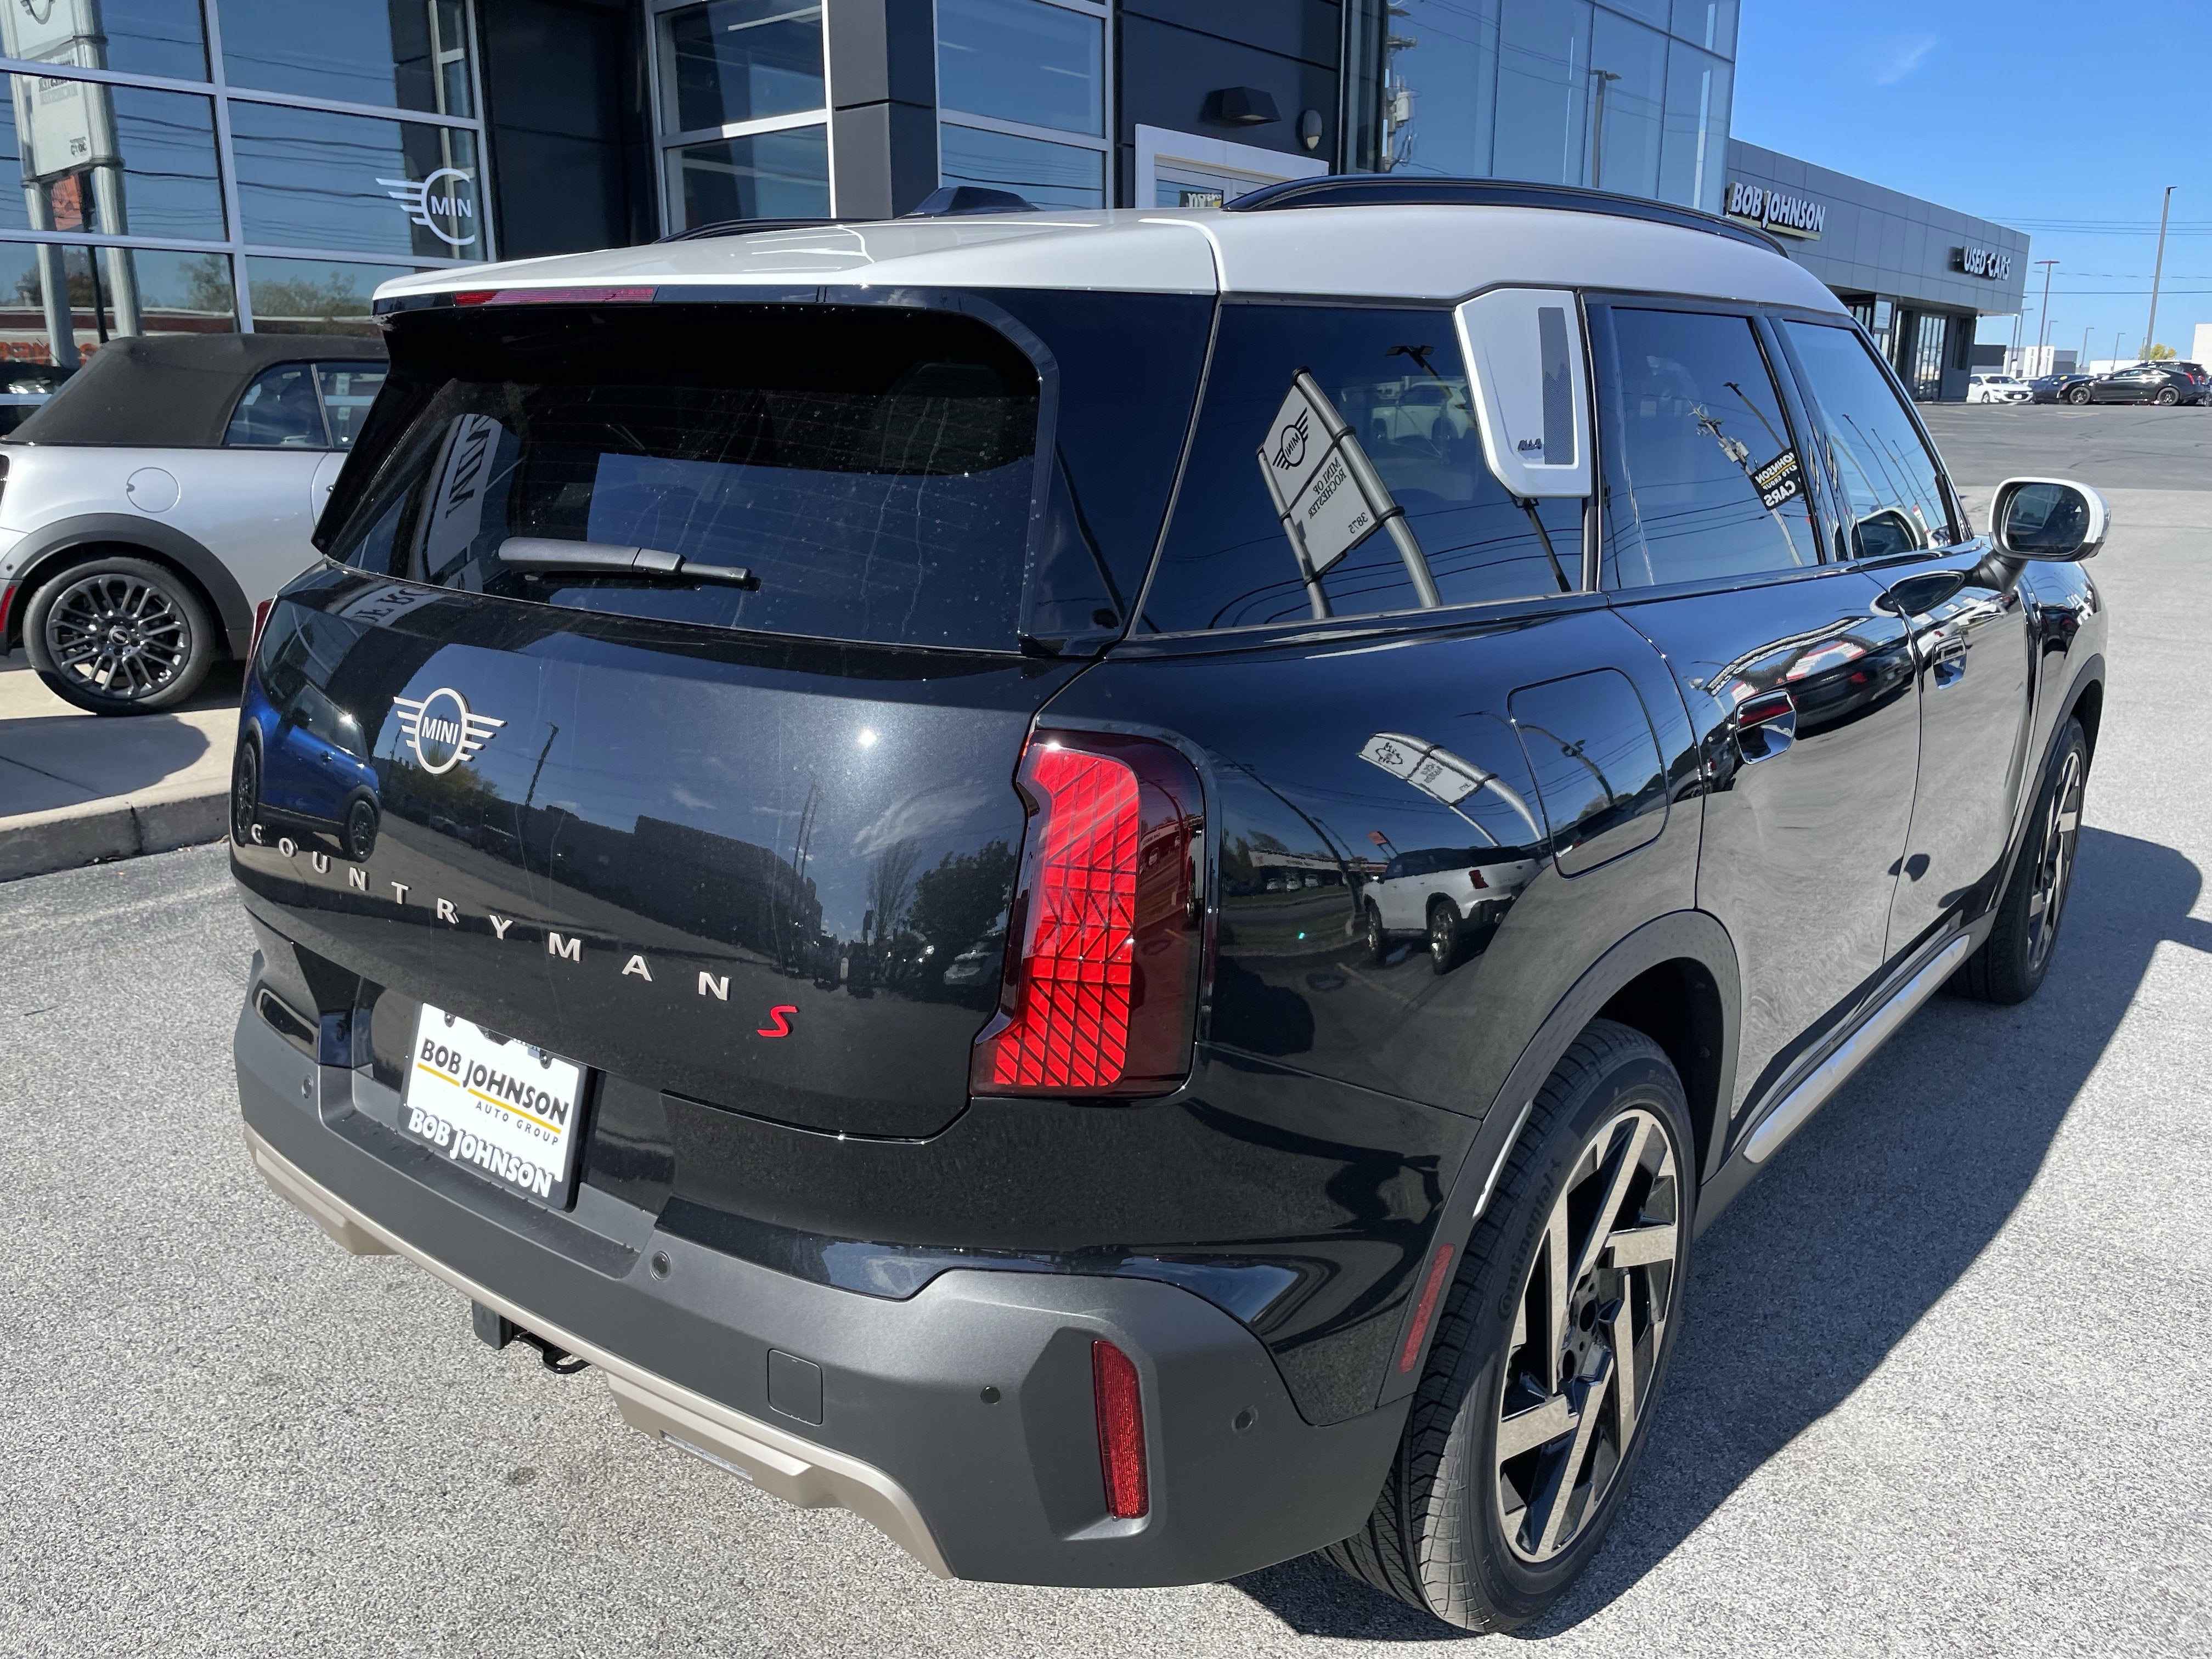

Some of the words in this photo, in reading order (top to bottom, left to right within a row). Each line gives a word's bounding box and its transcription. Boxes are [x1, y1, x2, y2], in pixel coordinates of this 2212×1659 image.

[1731, 182, 1764, 217] BOB
[1763, 190, 1826, 232] JOHNSON
[1964, 246, 1986, 274] USED
[1987, 252, 2011, 280] CARS
[421, 716, 459, 745] MINI
[251, 823, 731, 1001] COUNTRYMAN
[757, 1004, 799, 1038] S
[420, 1037, 462, 1075] BOB
[462, 1059, 569, 1125] JOHNSON
[476, 1101, 509, 1122] AUTO
[517, 1120, 559, 1146] GROUP
[408, 1107, 453, 1147] BOB
[450, 1128, 555, 1198] JOHNSON
